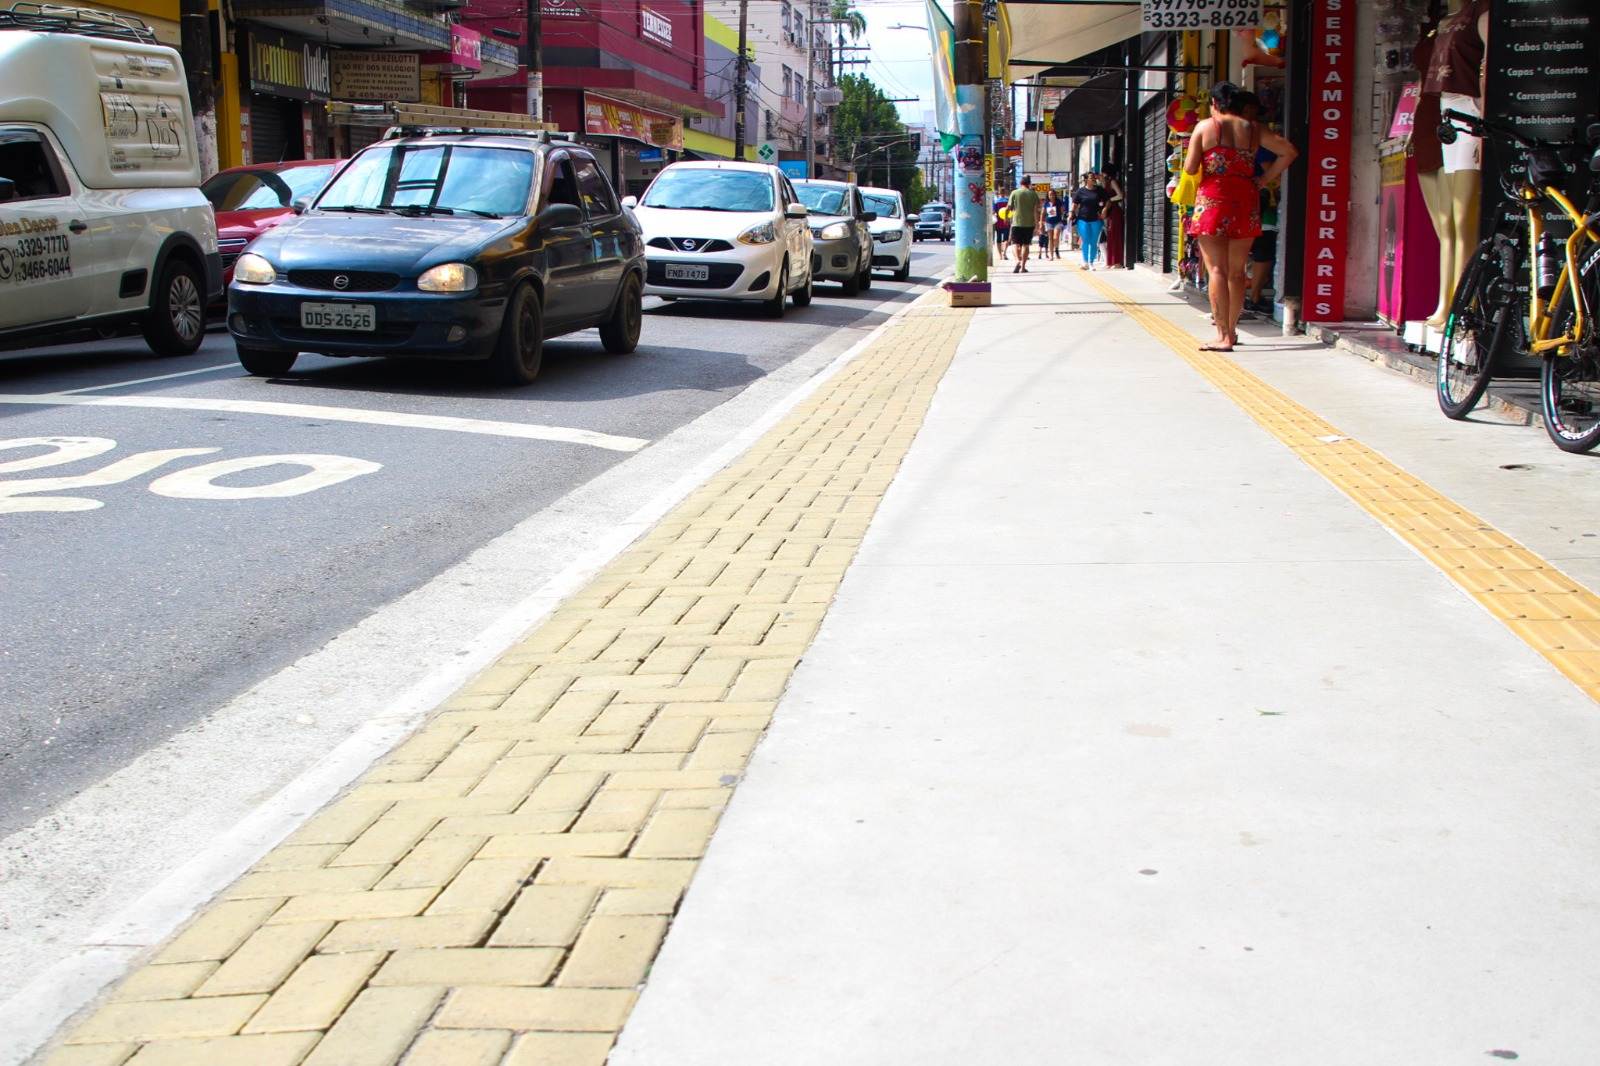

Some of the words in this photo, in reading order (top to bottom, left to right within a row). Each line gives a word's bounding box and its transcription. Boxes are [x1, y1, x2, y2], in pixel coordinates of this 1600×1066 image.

[642, 11, 672, 42] TENNESSEE
[1152, 10, 1260, 28] 3323-8624
[1513, 42, 1540, 52] Cabos
[1542, 40, 1584, 51] Originais
[303, 43, 331, 94] Outlet
[1507, 67, 1534, 77] Capas
[1544, 65, 1589, 75] Consertos
[1516, 90, 1577, 101] Carregadores
[1515, 114, 1576, 125] Desbloqueios
[18, 235, 69, 257] 3329-7770
[1315, 157, 1338, 316] CELURARES
[21, 256, 71, 281] 3466-6044
